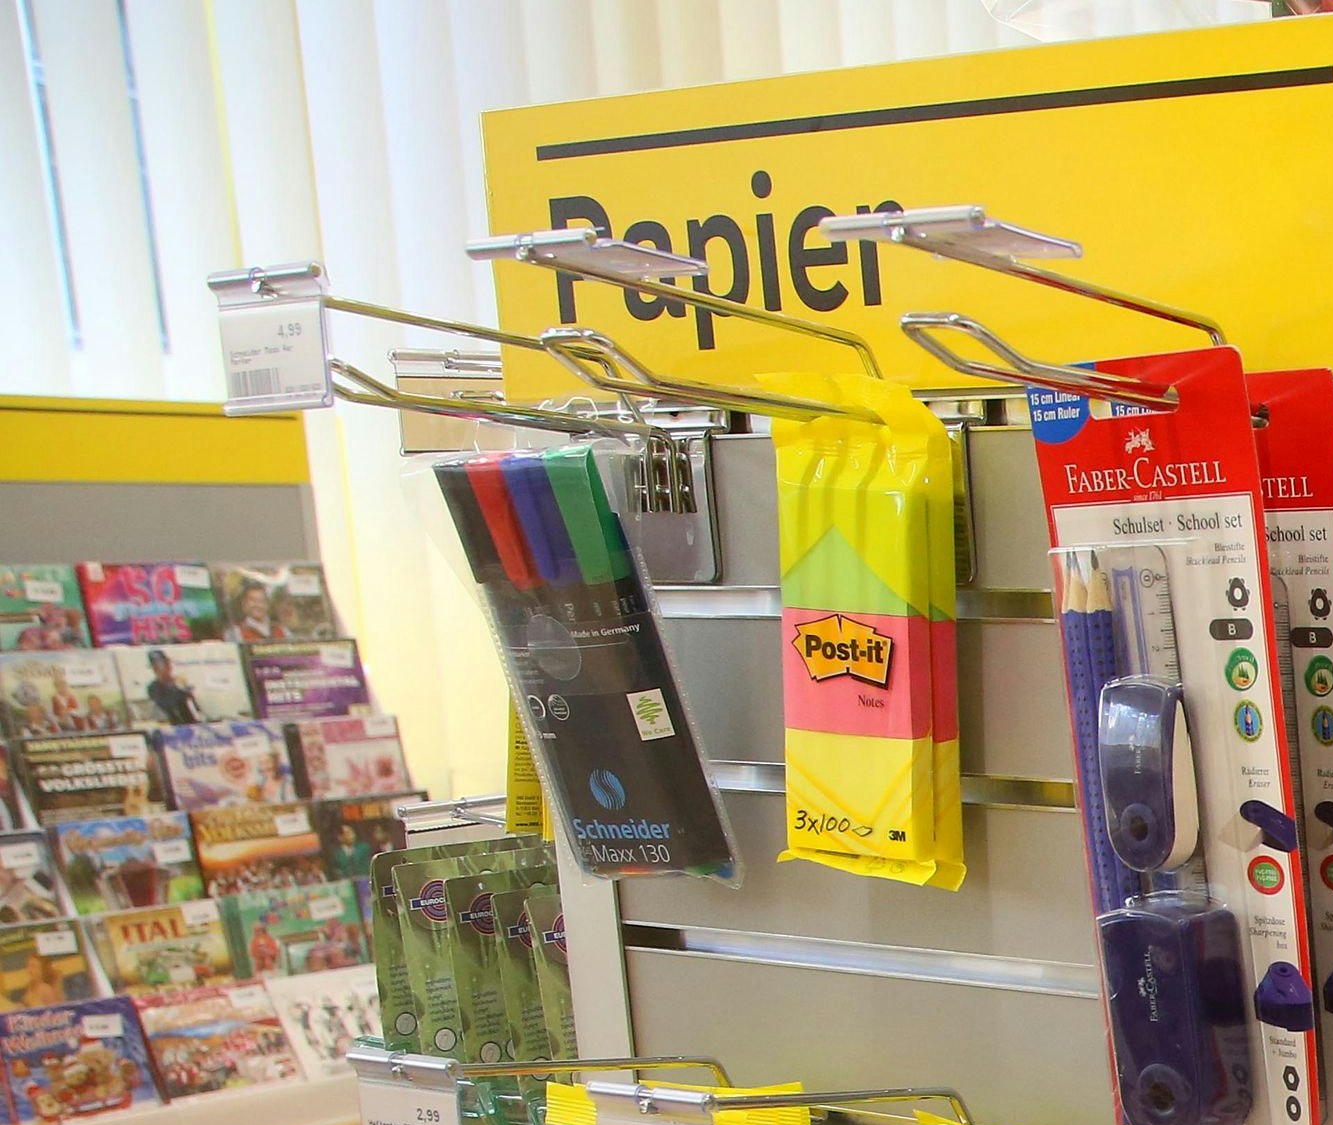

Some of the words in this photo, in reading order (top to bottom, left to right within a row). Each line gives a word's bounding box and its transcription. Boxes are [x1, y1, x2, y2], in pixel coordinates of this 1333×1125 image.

[547, 170, 904, 351] Papier
[277, 322, 302, 339] 4,99
[1030, 393, 1039, 406] 15
[1040, 394, 1054, 405] cm
[1033, 409, 1042, 422] 15
[1043, 410, 1056, 421] cm
[1057, 407, 1081, 421] Ruler
[1063, 456, 1227, 494] FABER-CASTELL
[1113, 517, 1165, 536] Schulset
[1176, 513, 1220, 532] School
[1224, 513, 1243, 530] set
[1309, 527, 1328, 542] set
[600, 623, 641, 637] Germany
[1228, 623, 1236, 637] B
[1308, 631, 1317, 644] B
[803, 634, 888, 666] Post-it
[857, 694, 886, 709] Notes
[572, 817, 672, 842] Schneider
[794, 810, 849, 837] 3x100
[888, 829, 907, 844] 3M
[592, 844, 635, 866] Maxx
[639, 844, 672, 866] 130
[417, 1108, 440, 1123] 2,99
